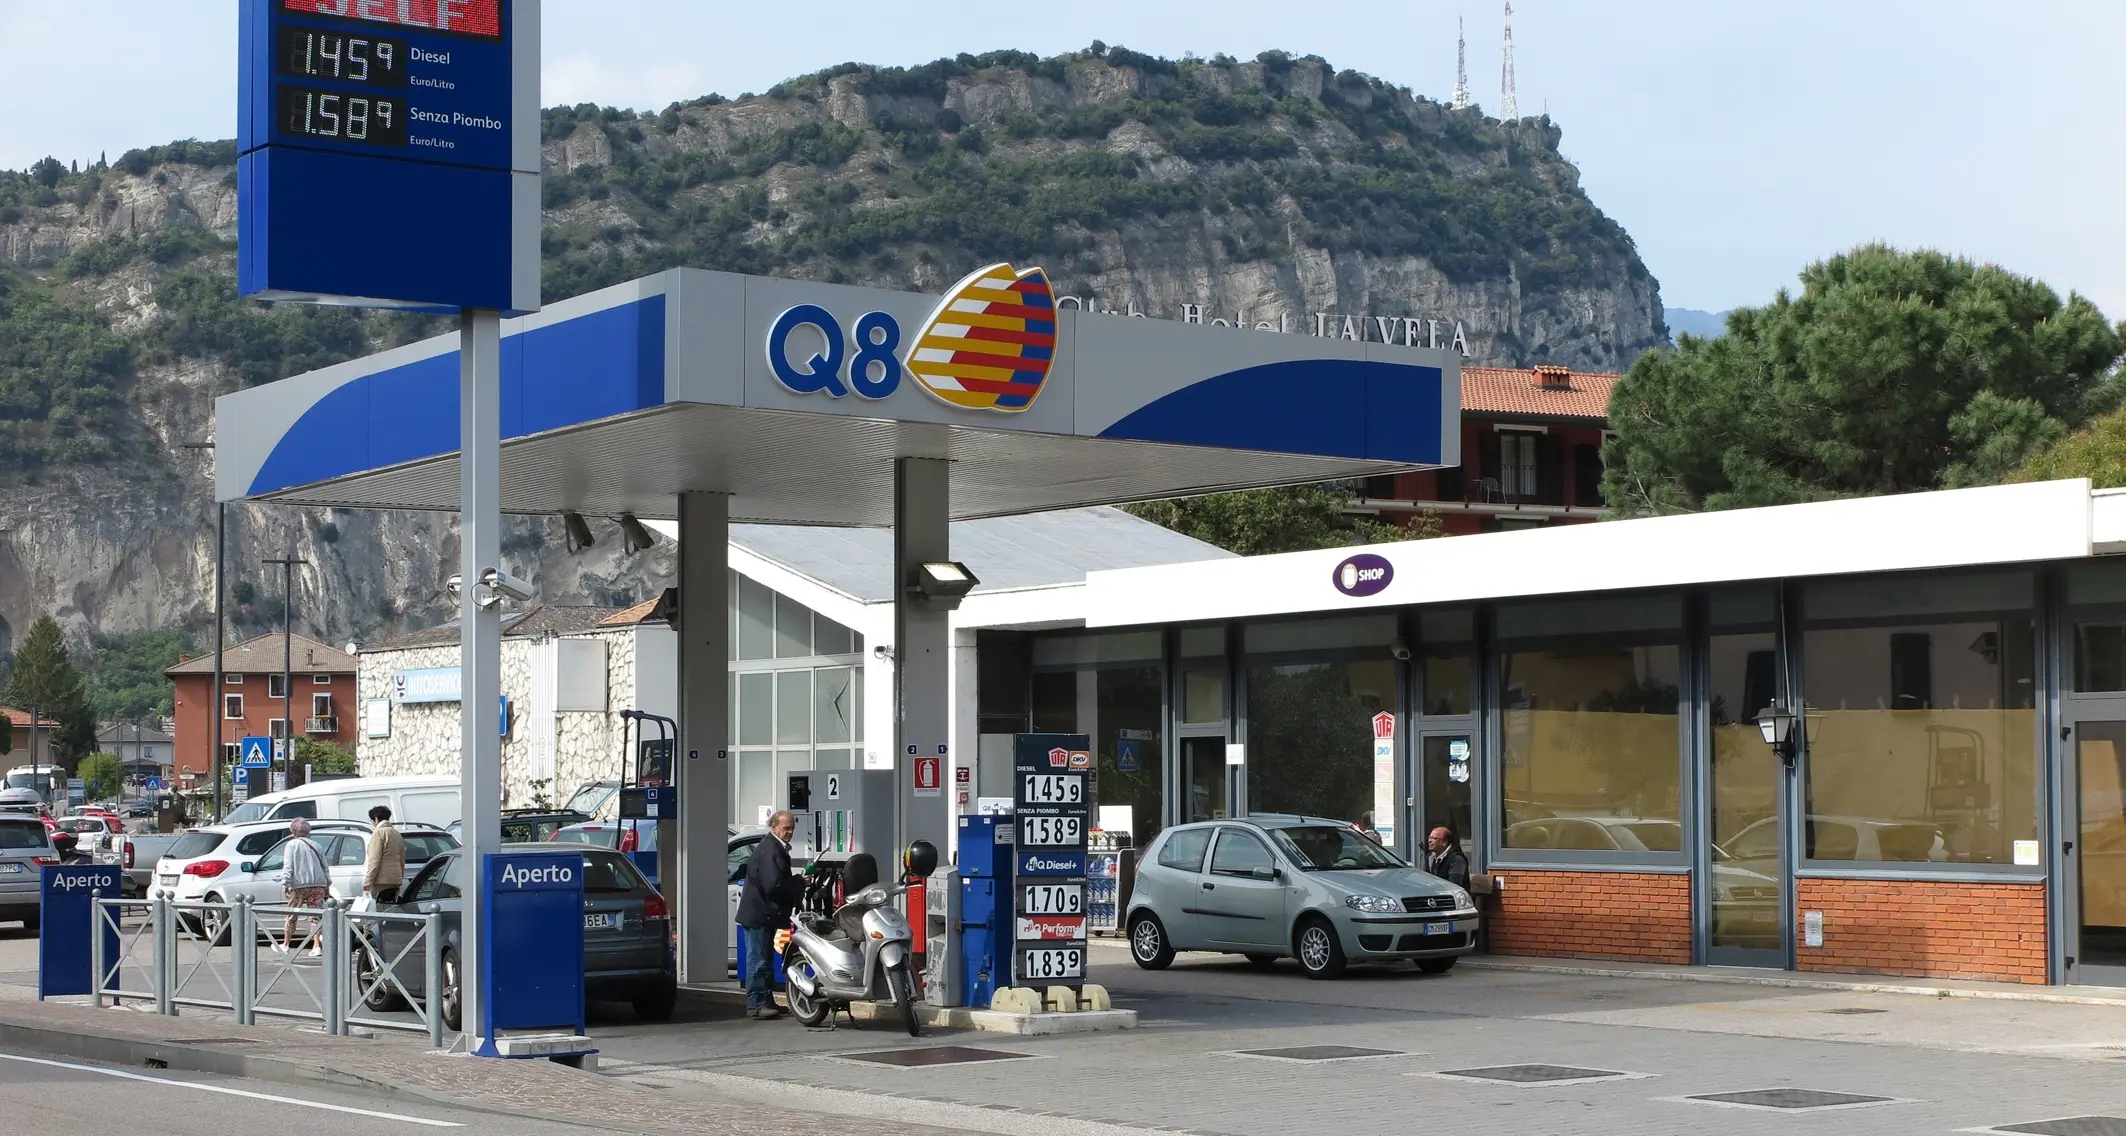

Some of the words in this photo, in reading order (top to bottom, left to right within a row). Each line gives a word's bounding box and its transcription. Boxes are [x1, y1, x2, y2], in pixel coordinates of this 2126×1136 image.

[410, 48, 451, 65] Diesel
[410, 76, 455, 90] Euro/Litro
[410, 108, 449, 124] Senza
[453, 113, 502, 130] Piombo
[410, 136, 455, 149] Euro/Litro
[1375, 316, 1471, 357] VELA
[766, 303, 902, 400] Q8
[1358, 568, 1385, 581] SHOP
[1375, 714, 1393, 737] UTA
[1050, 749, 1067, 765] UTA
[235, 768, 248, 783] P
[829, 777, 838, 796] 2
[1027, 776, 1080, 801] 1,459
[1026, 818, 1078, 844] 1,589
[1046, 860, 1077, 870] Diesel+
[53, 872, 112, 891] Aperto
[501, 863, 572, 889] Aperto
[1027, 887, 1079, 912] 1,709
[1027, 951, 1079, 977] 1,839
